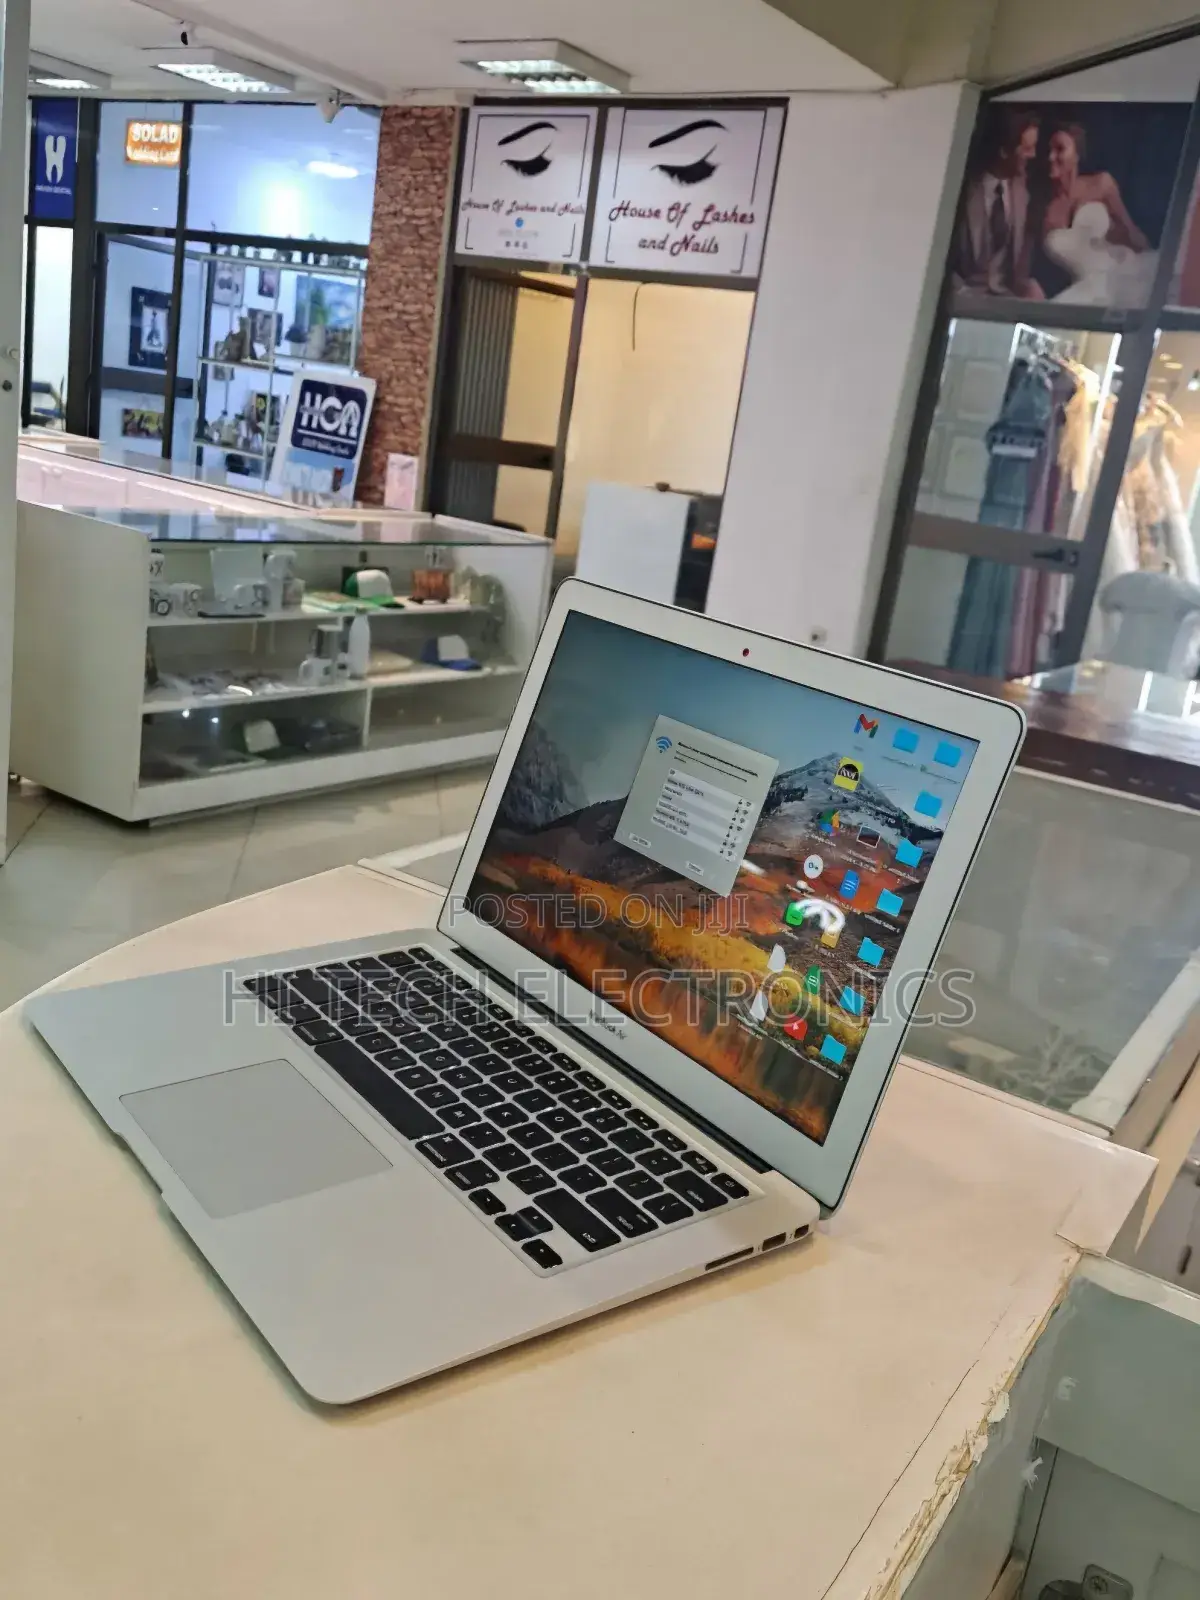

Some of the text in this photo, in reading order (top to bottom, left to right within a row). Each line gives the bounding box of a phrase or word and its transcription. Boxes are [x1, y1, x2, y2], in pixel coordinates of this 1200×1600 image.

[608, 200, 755, 231] House Of Lashes
[638, 233, 719, 257] and Nails
